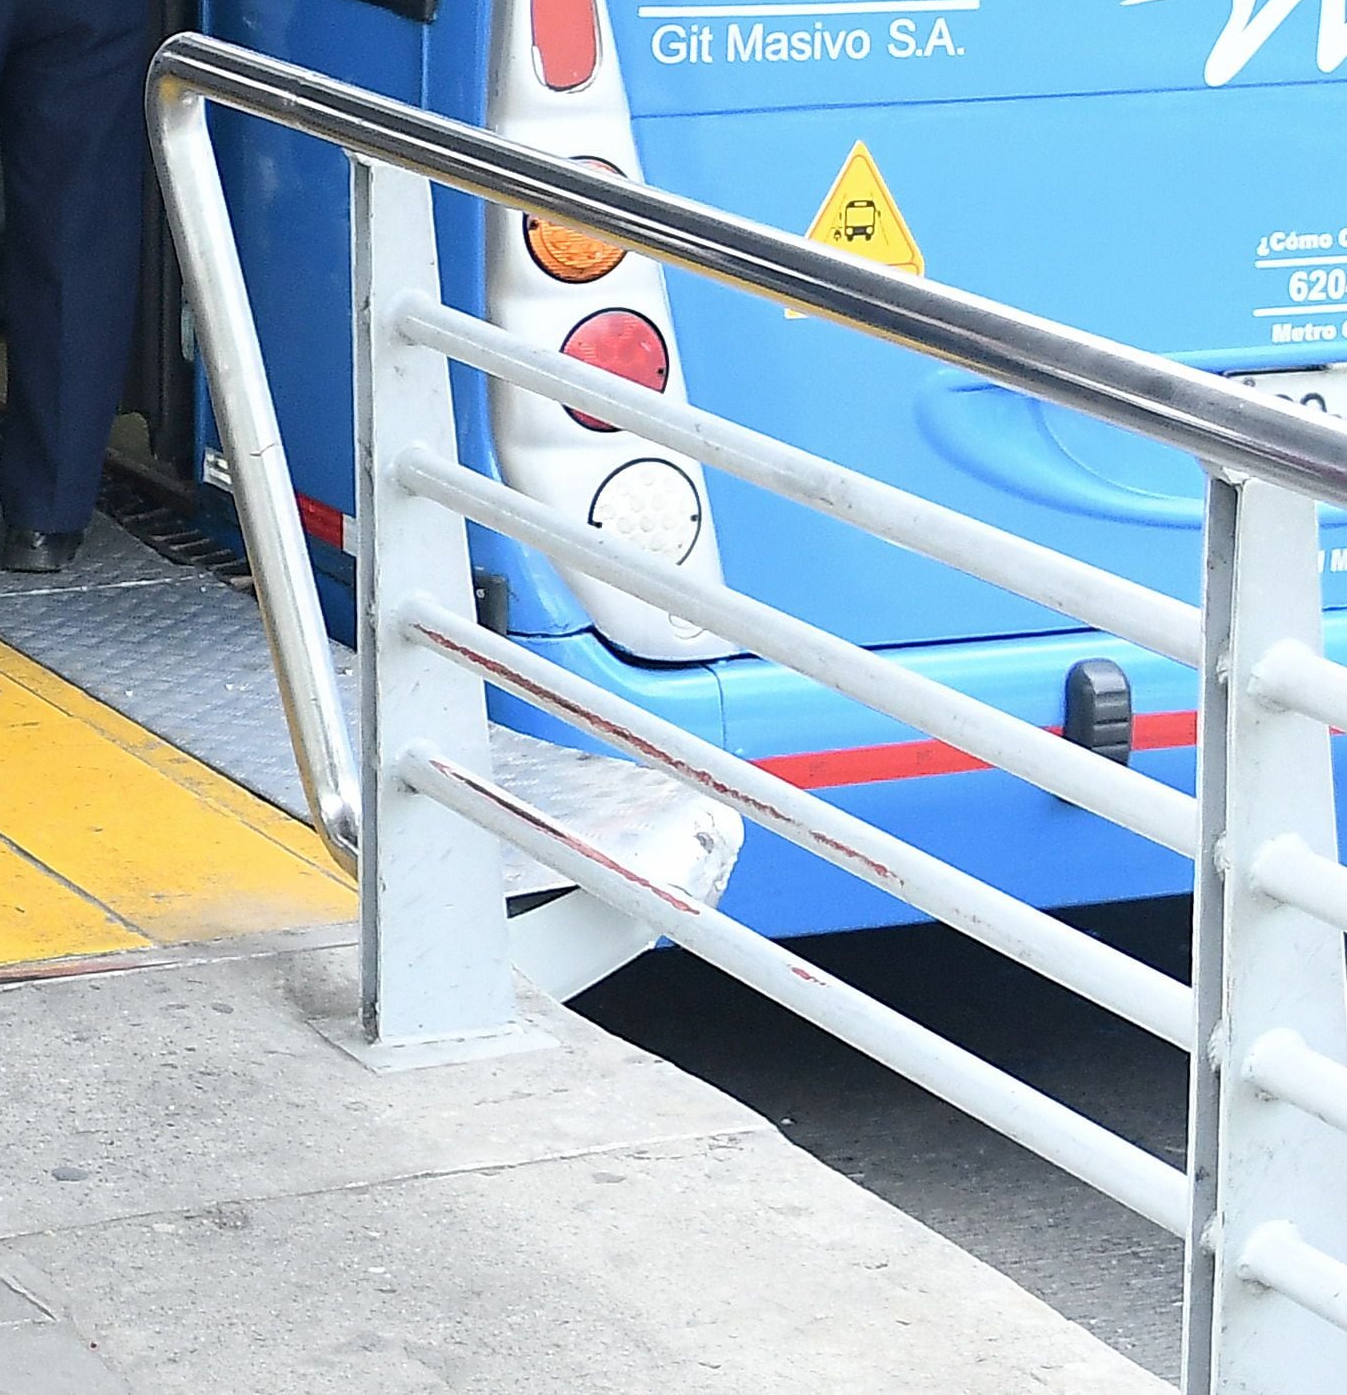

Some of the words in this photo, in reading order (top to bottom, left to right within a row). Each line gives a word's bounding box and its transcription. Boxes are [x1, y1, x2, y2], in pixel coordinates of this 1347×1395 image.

[651, 23, 714, 65] Git
[726, 20, 871, 63] Masivo
[887, 17, 966, 59] S.A.
[1256, 231, 1334, 257] ¿Cómo
[1288, 267, 1347, 303] 620
[1271, 321, 1337, 344] Metro
